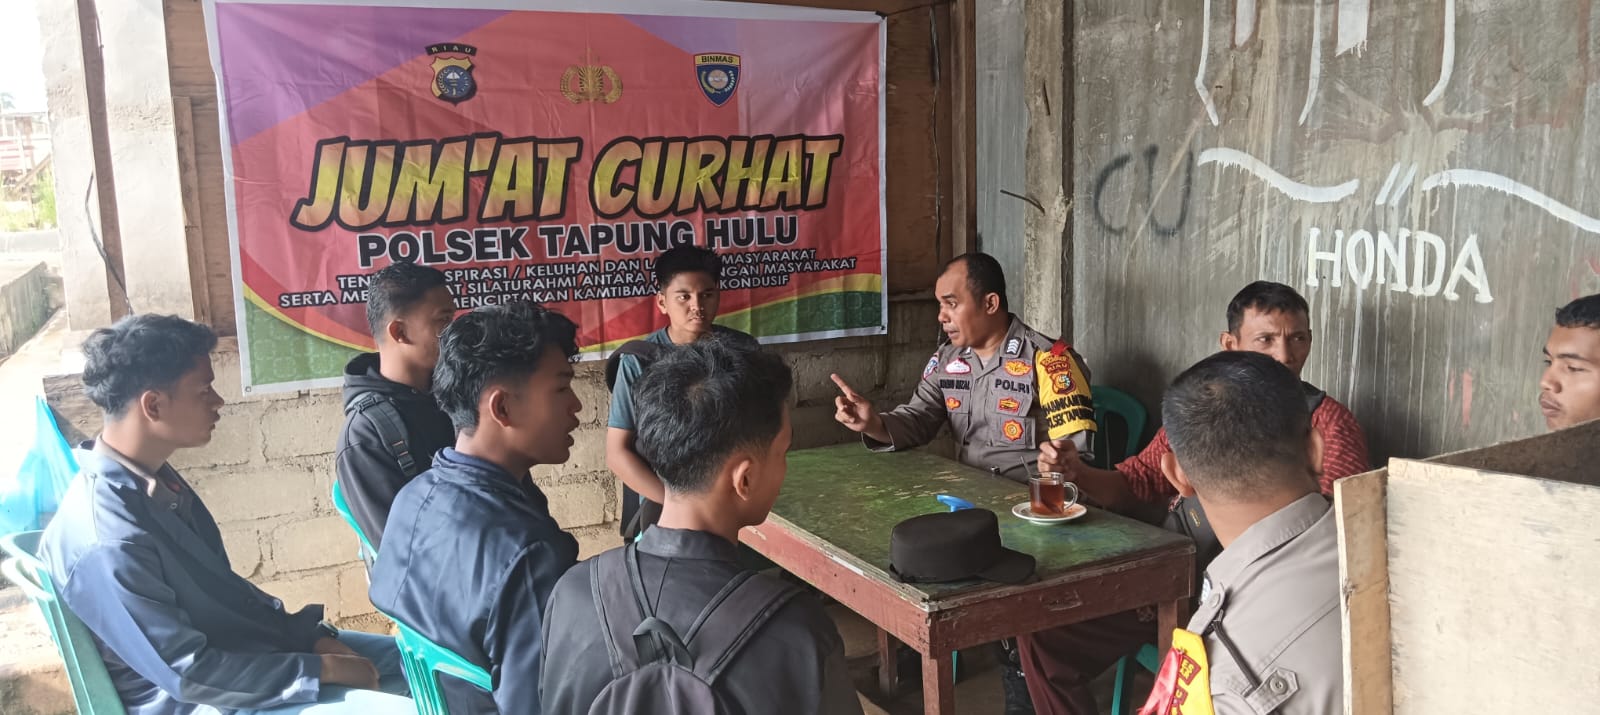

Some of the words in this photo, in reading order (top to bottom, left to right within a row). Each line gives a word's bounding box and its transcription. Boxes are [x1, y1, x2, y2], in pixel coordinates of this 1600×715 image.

[431, 45, 472, 53] RIAU
[701, 55, 733, 63] BINMAS
[290, 132, 583, 231] JUM'AT
[589, 134, 844, 218] CURHAT
[358, 226, 530, 267] POLSEK
[539, 221, 694, 258] TAPUNG
[706, 216, 799, 249] HULU
[444, 266, 507, 282] SPIRASI
[526, 261, 599, 277] KELUHAN
[605, 259, 639, 272] DAN
[721, 250, 816, 264] MASYARAKAT
[1306, 227, 1493, 302] HONDA
[280, 292, 336, 307] SERTA
[467, 277, 576, 294] SILATURAHMI
[582, 273, 649, 286] ANTARA
[764, 258, 857, 274] MASYARAKAT
[720, 276, 789, 289] KONDUSIF
[995, 378, 1030, 394] POLRI
